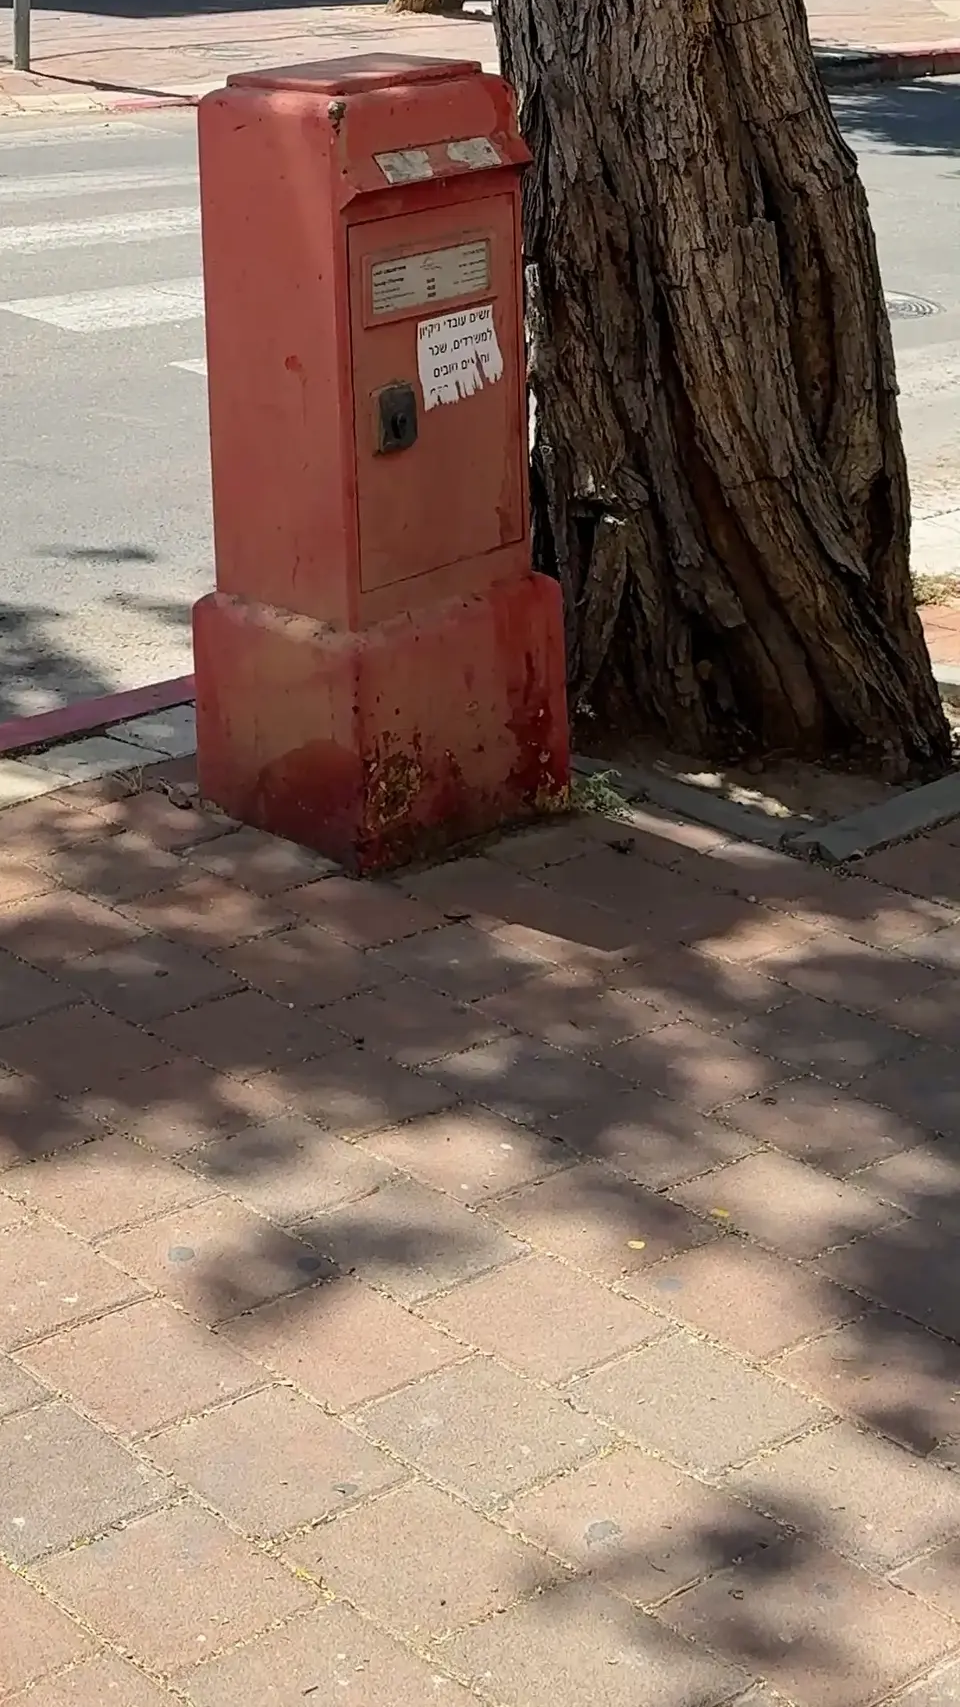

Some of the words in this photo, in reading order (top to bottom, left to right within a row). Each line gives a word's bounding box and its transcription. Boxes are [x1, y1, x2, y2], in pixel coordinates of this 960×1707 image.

[443, 315, 467, 329] עובדי
[419, 323, 441, 340] ניקיון
[428, 342, 448, 356] שכר
